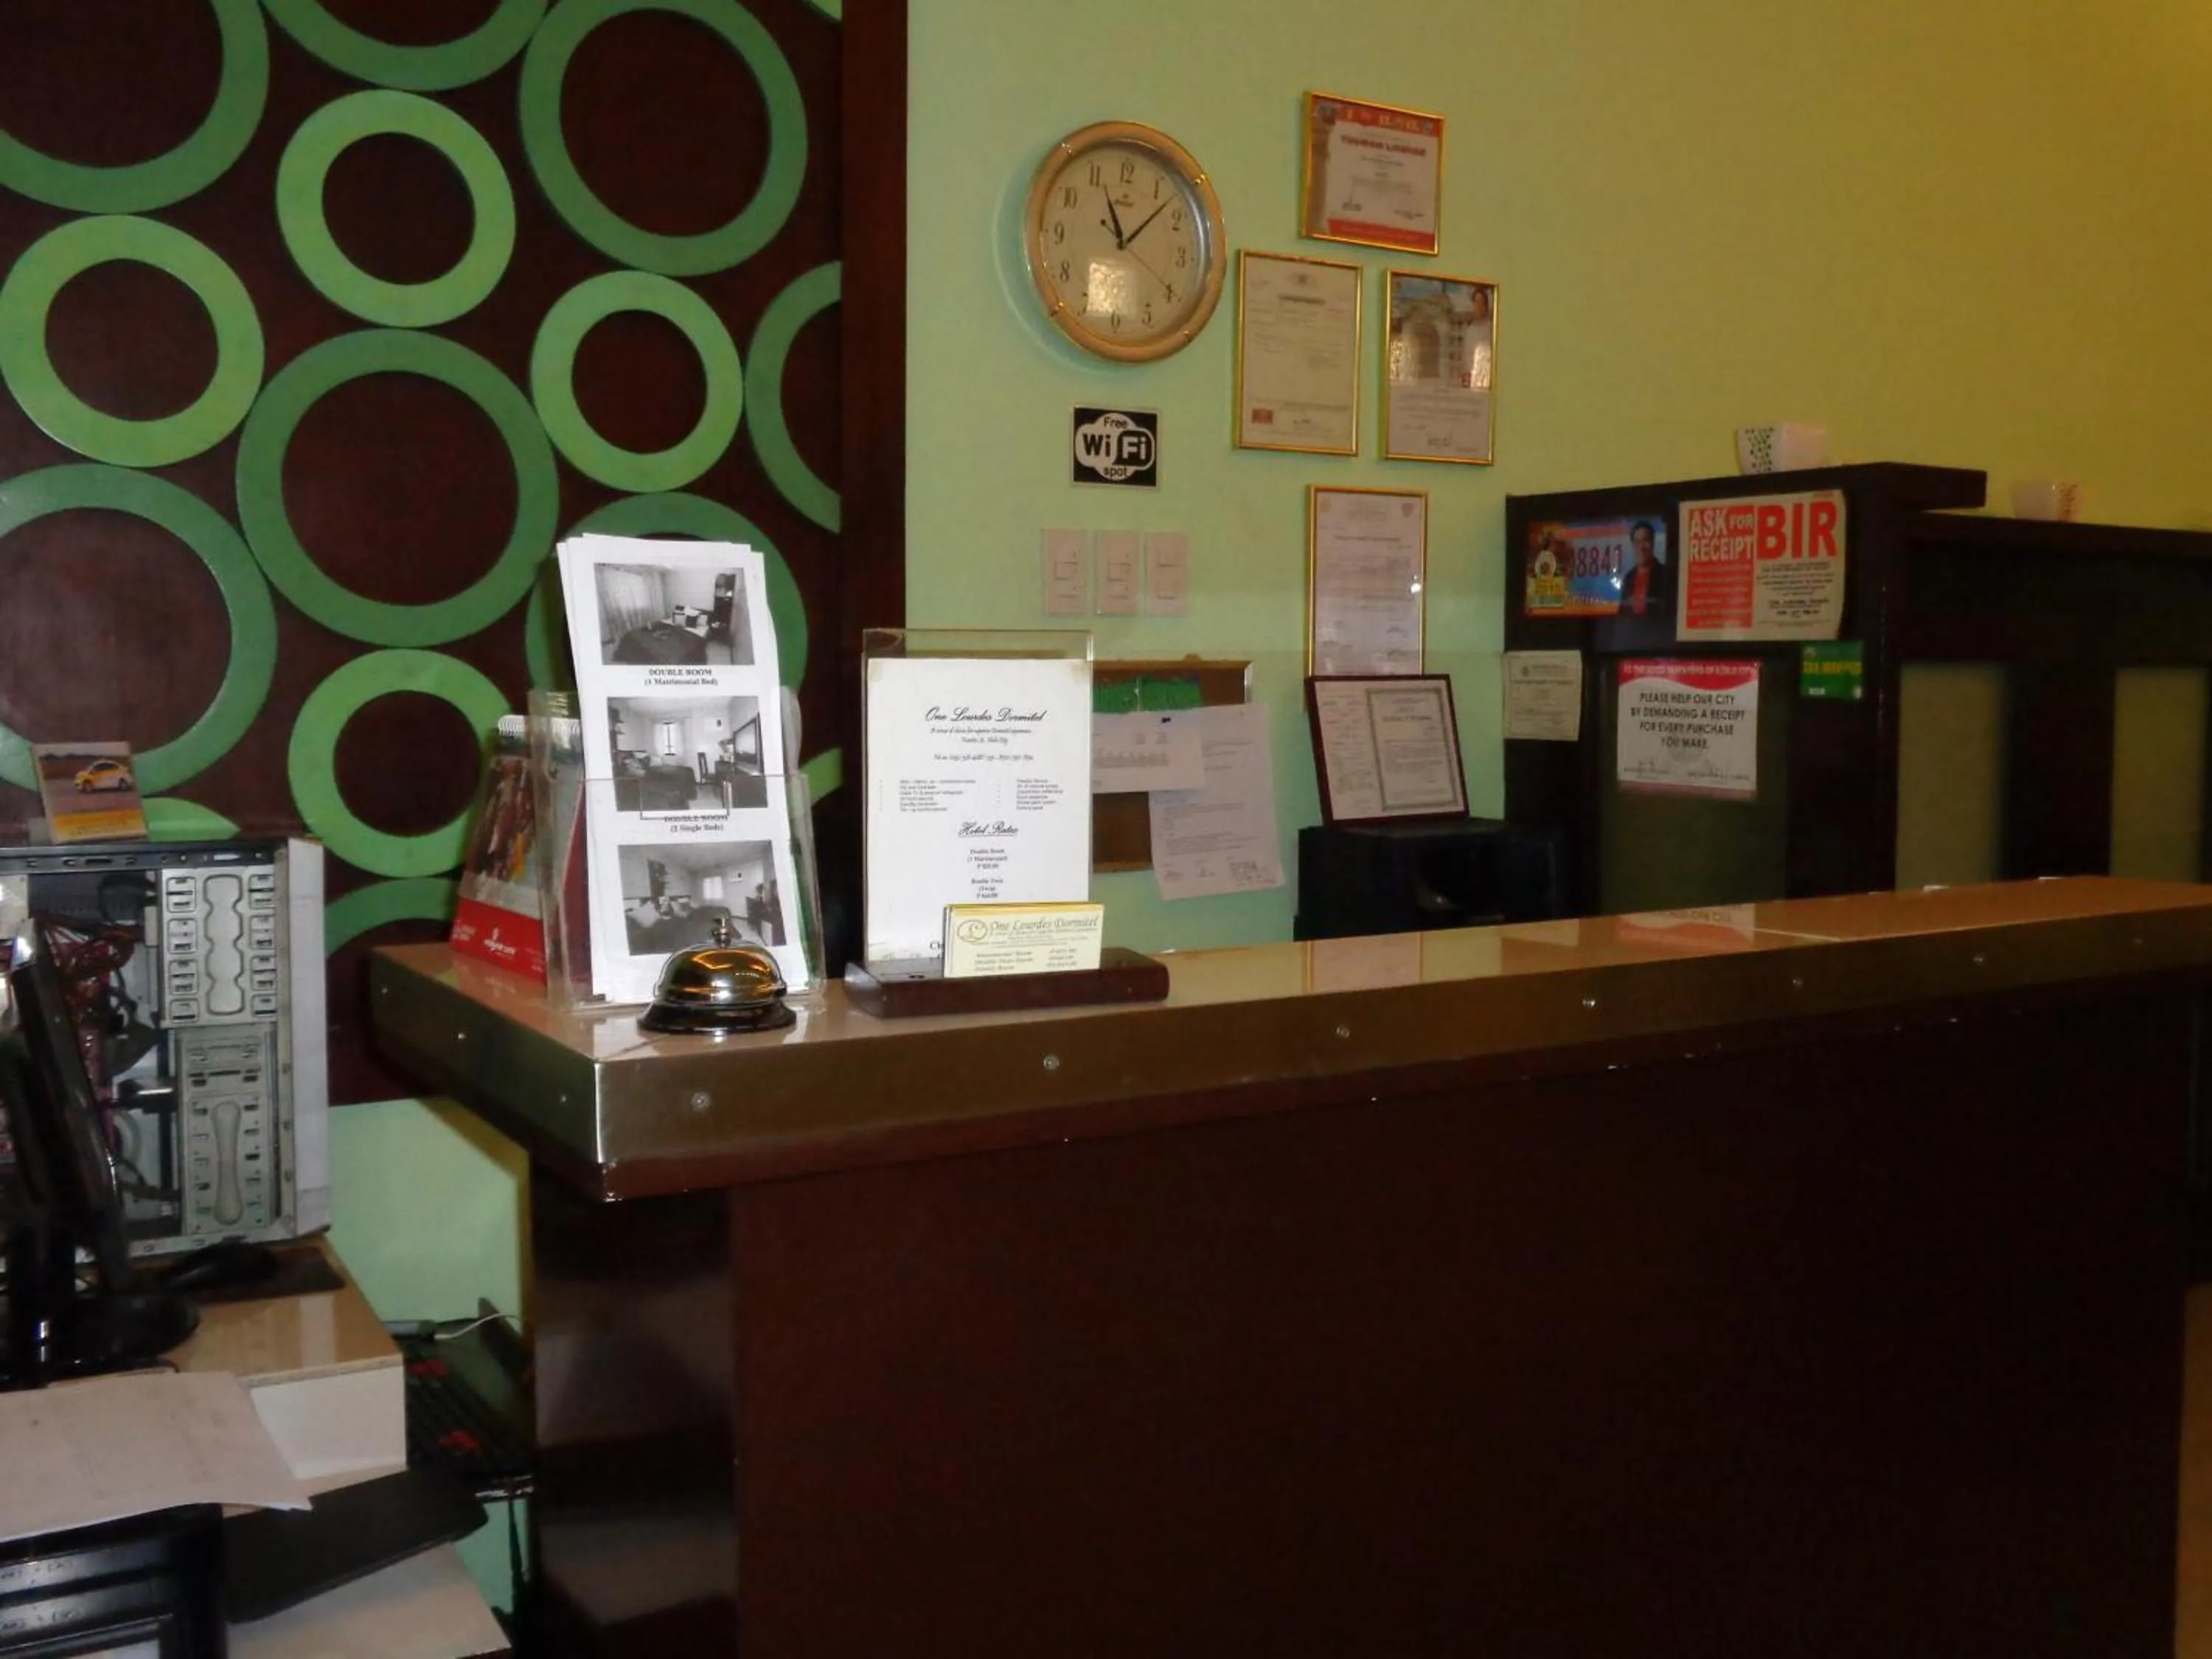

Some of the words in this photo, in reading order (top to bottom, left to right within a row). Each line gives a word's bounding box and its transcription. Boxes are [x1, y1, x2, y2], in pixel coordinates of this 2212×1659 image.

[1089, 161, 1101, 187] 11
[1120, 161, 1135, 185] 12
[1063, 187, 1078, 209] 10
[1171, 209, 1182, 232] 2
[1054, 221, 1065, 245] 9
[1175, 247, 1186, 268] 3
[1059, 260, 1071, 283] 8
[1104, 417, 1127, 428] Free
[1104, 466, 1127, 479] spot
[1690, 509, 1728, 537] ASK
[1730, 514, 1753, 529] FOR
[1756, 501, 1838, 560] BIR
[1689, 535, 1753, 563] RECEIPT
[649, 668, 684, 677] DOUBLE
[686, 668, 712, 677] ROOM
[654, 678, 700, 686] Matrimonial
[1640, 692, 1669, 704] PLEASE
[1672, 693, 1691, 704] HELP
[1693, 694, 1713, 704] OUR
[1716, 695, 1734, 706] CITY
[925, 706, 947, 722] One
[950, 706, 992, 722] Lourdes
[1631, 707, 1641, 717] BY
[1644, 708, 1698, 719] DEMANDING
[1710, 709, 1745, 722] RECEIPT
[1640, 722, 1656, 731] FOR
[1658, 723, 1684, 733] EVERY
[1686, 723, 1734, 736] PURCHASE
[1661, 737, 1680, 748] YOU
[958, 821, 990, 835] Hotel
[991, 820, 1019, 834] Rates
